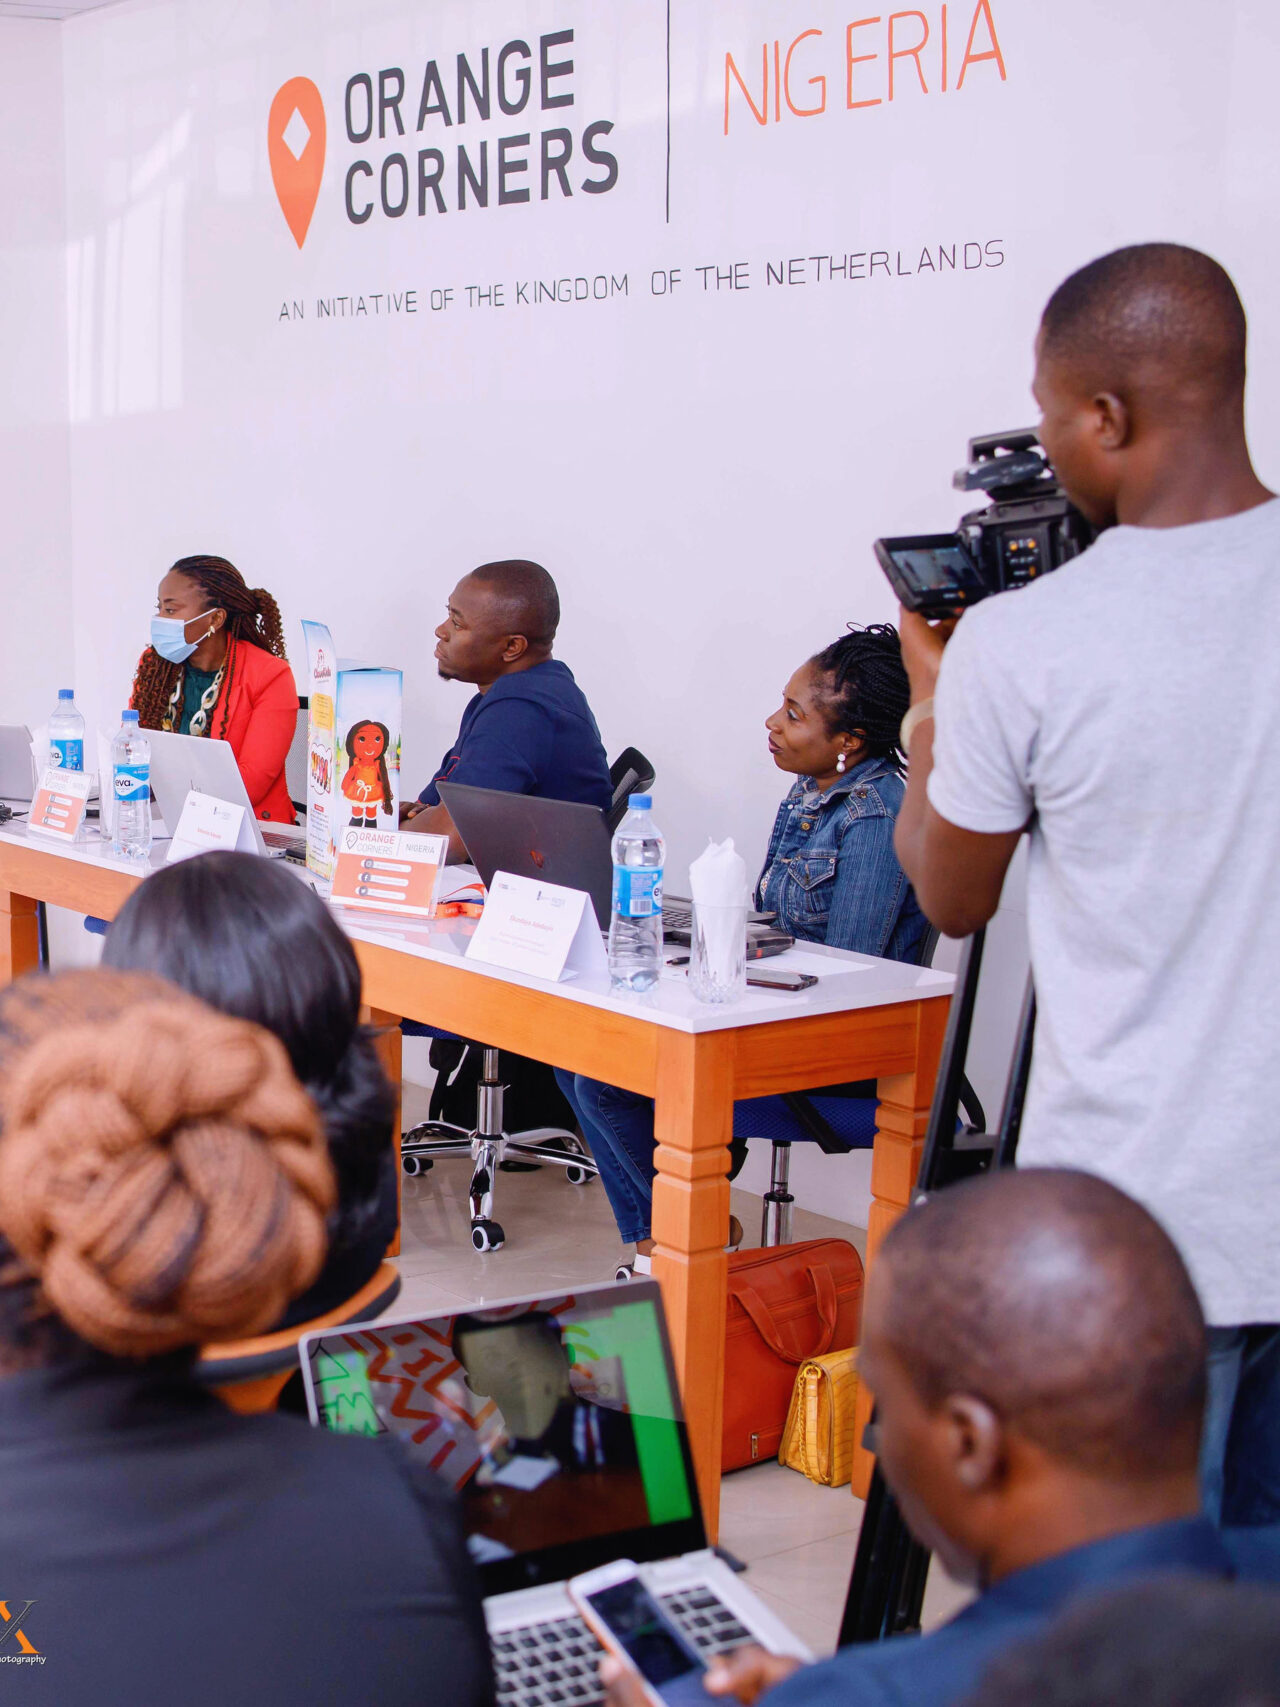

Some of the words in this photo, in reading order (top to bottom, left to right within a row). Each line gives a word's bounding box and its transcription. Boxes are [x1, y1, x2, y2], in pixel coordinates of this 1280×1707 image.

[345, 28, 574, 144] ORANGE
[723, 0, 1007, 136] NIGERIA
[345, 120, 619, 225] CORNERS
[278, 300, 305, 321] AN
[316, 291, 417, 318] INITIATIVE
[430, 288, 454, 311] OF
[465, 284, 505, 308] THE
[516, 273, 629, 305] KINGDOM
[651, 269, 681, 295] OF
[695, 262, 750, 291] THE
[766, 239, 1005, 286] NETHERLANDS
[357, 843, 393, 856] CORNERS
[360, 832, 396, 845] ORANGE
[405, 843, 435, 855] NIGERIA
